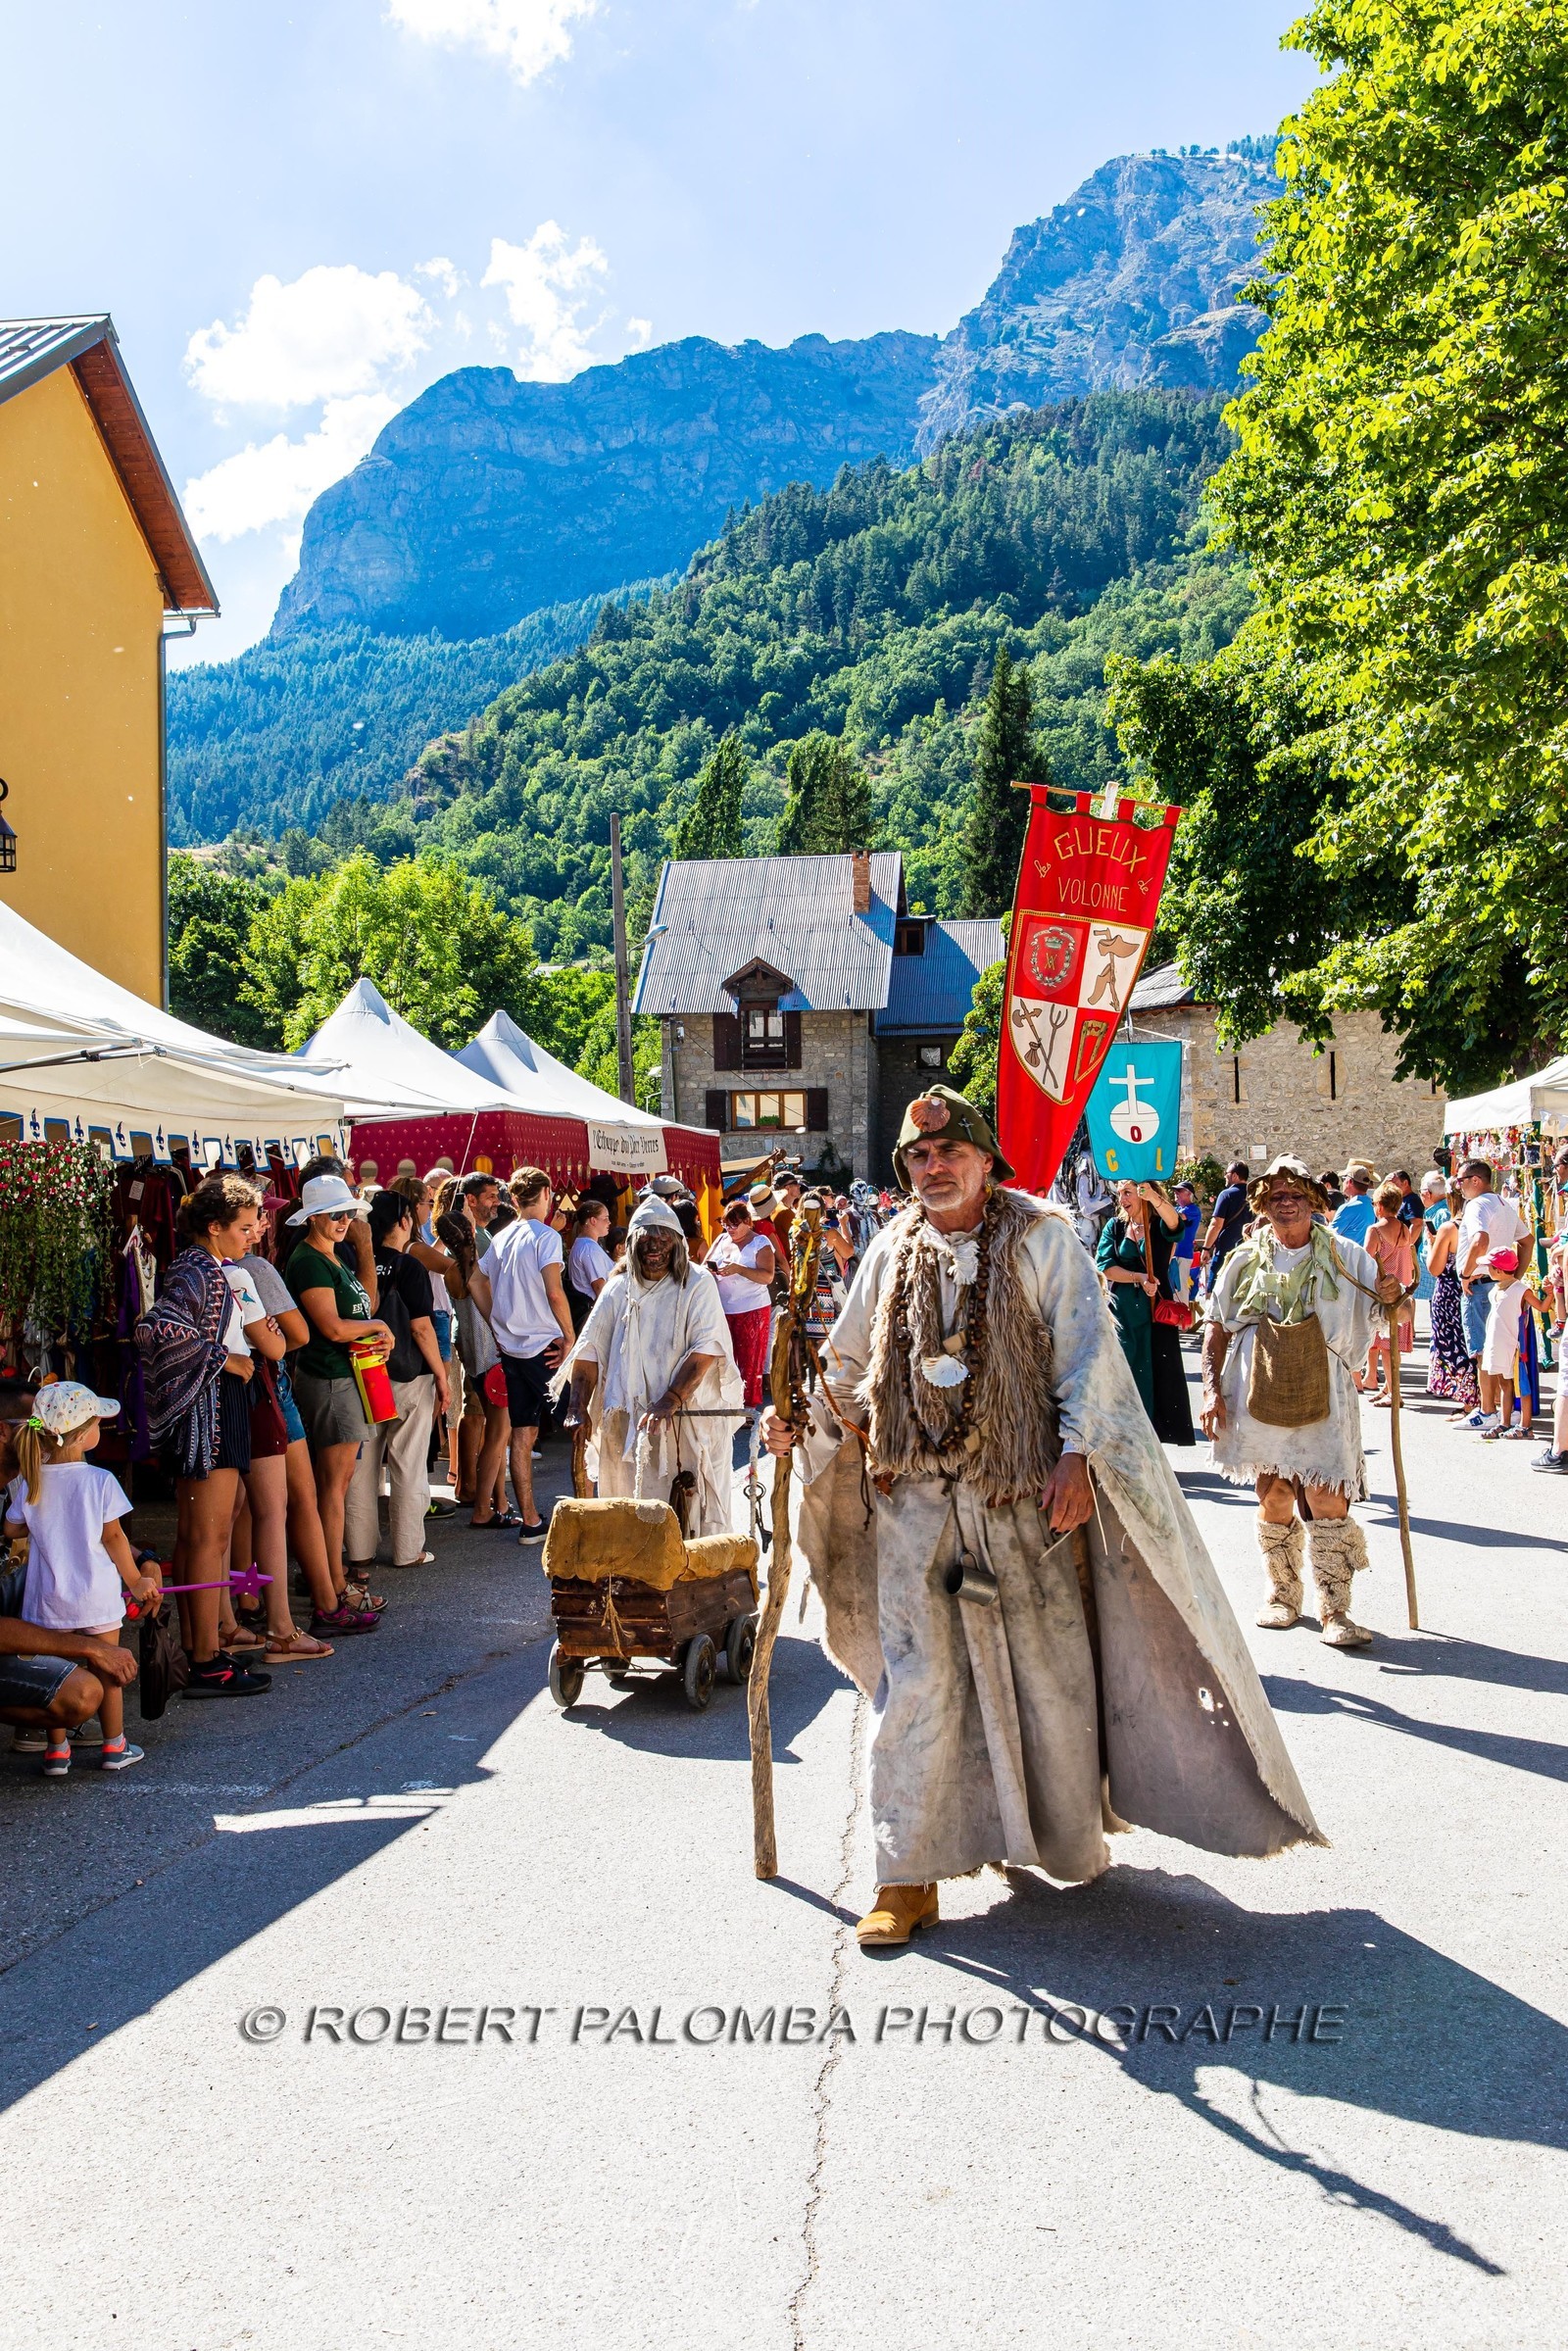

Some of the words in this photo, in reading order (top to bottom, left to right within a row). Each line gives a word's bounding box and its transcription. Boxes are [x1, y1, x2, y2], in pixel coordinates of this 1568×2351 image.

[1054, 826, 1148, 874] GUEUX
[1137, 877, 1153, 896] de
[1057, 876, 1130, 912] VOLONNE
